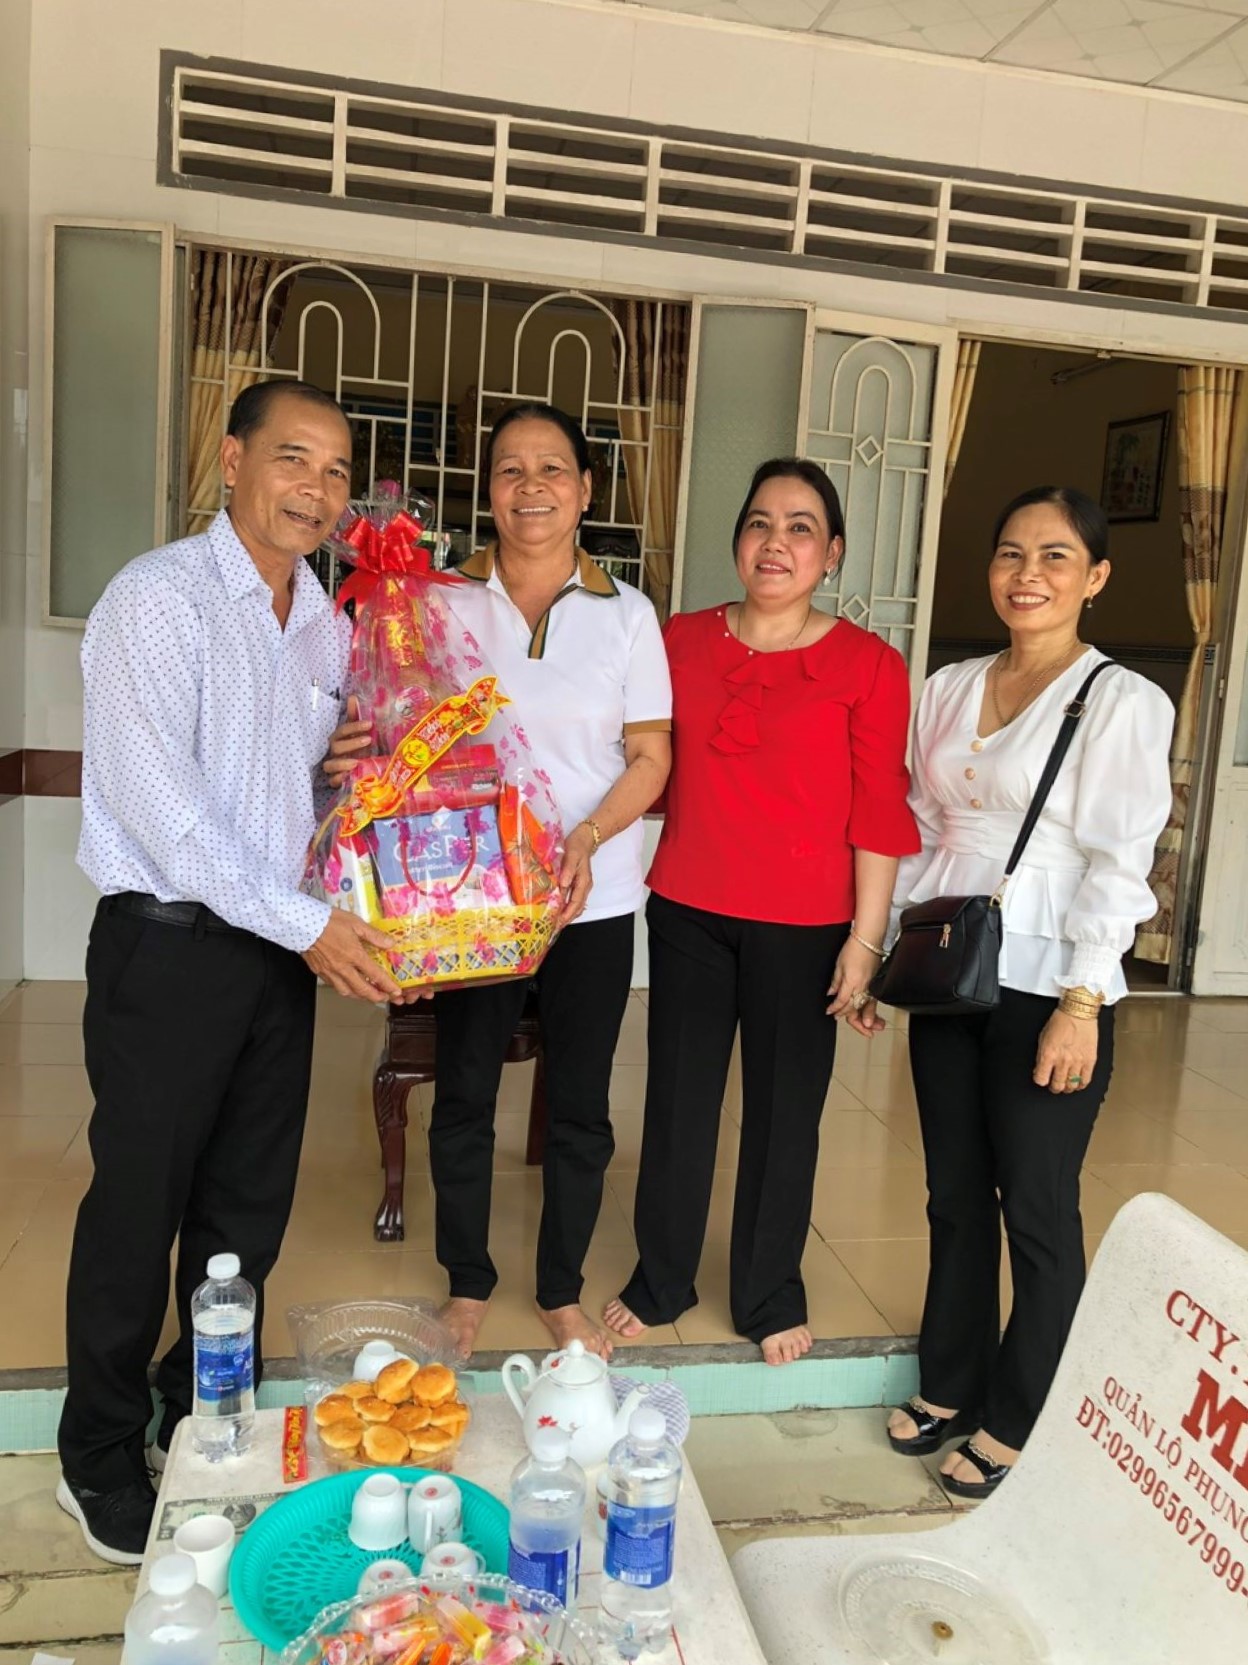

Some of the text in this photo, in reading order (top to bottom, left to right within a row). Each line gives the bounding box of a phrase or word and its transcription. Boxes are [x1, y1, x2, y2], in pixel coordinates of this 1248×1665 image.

[1165, 1289, 1248, 1387] CTY.
[1102, 1376, 1157, 1439] QUẢN
[1154, 1428, 1183, 1470] LỘ
